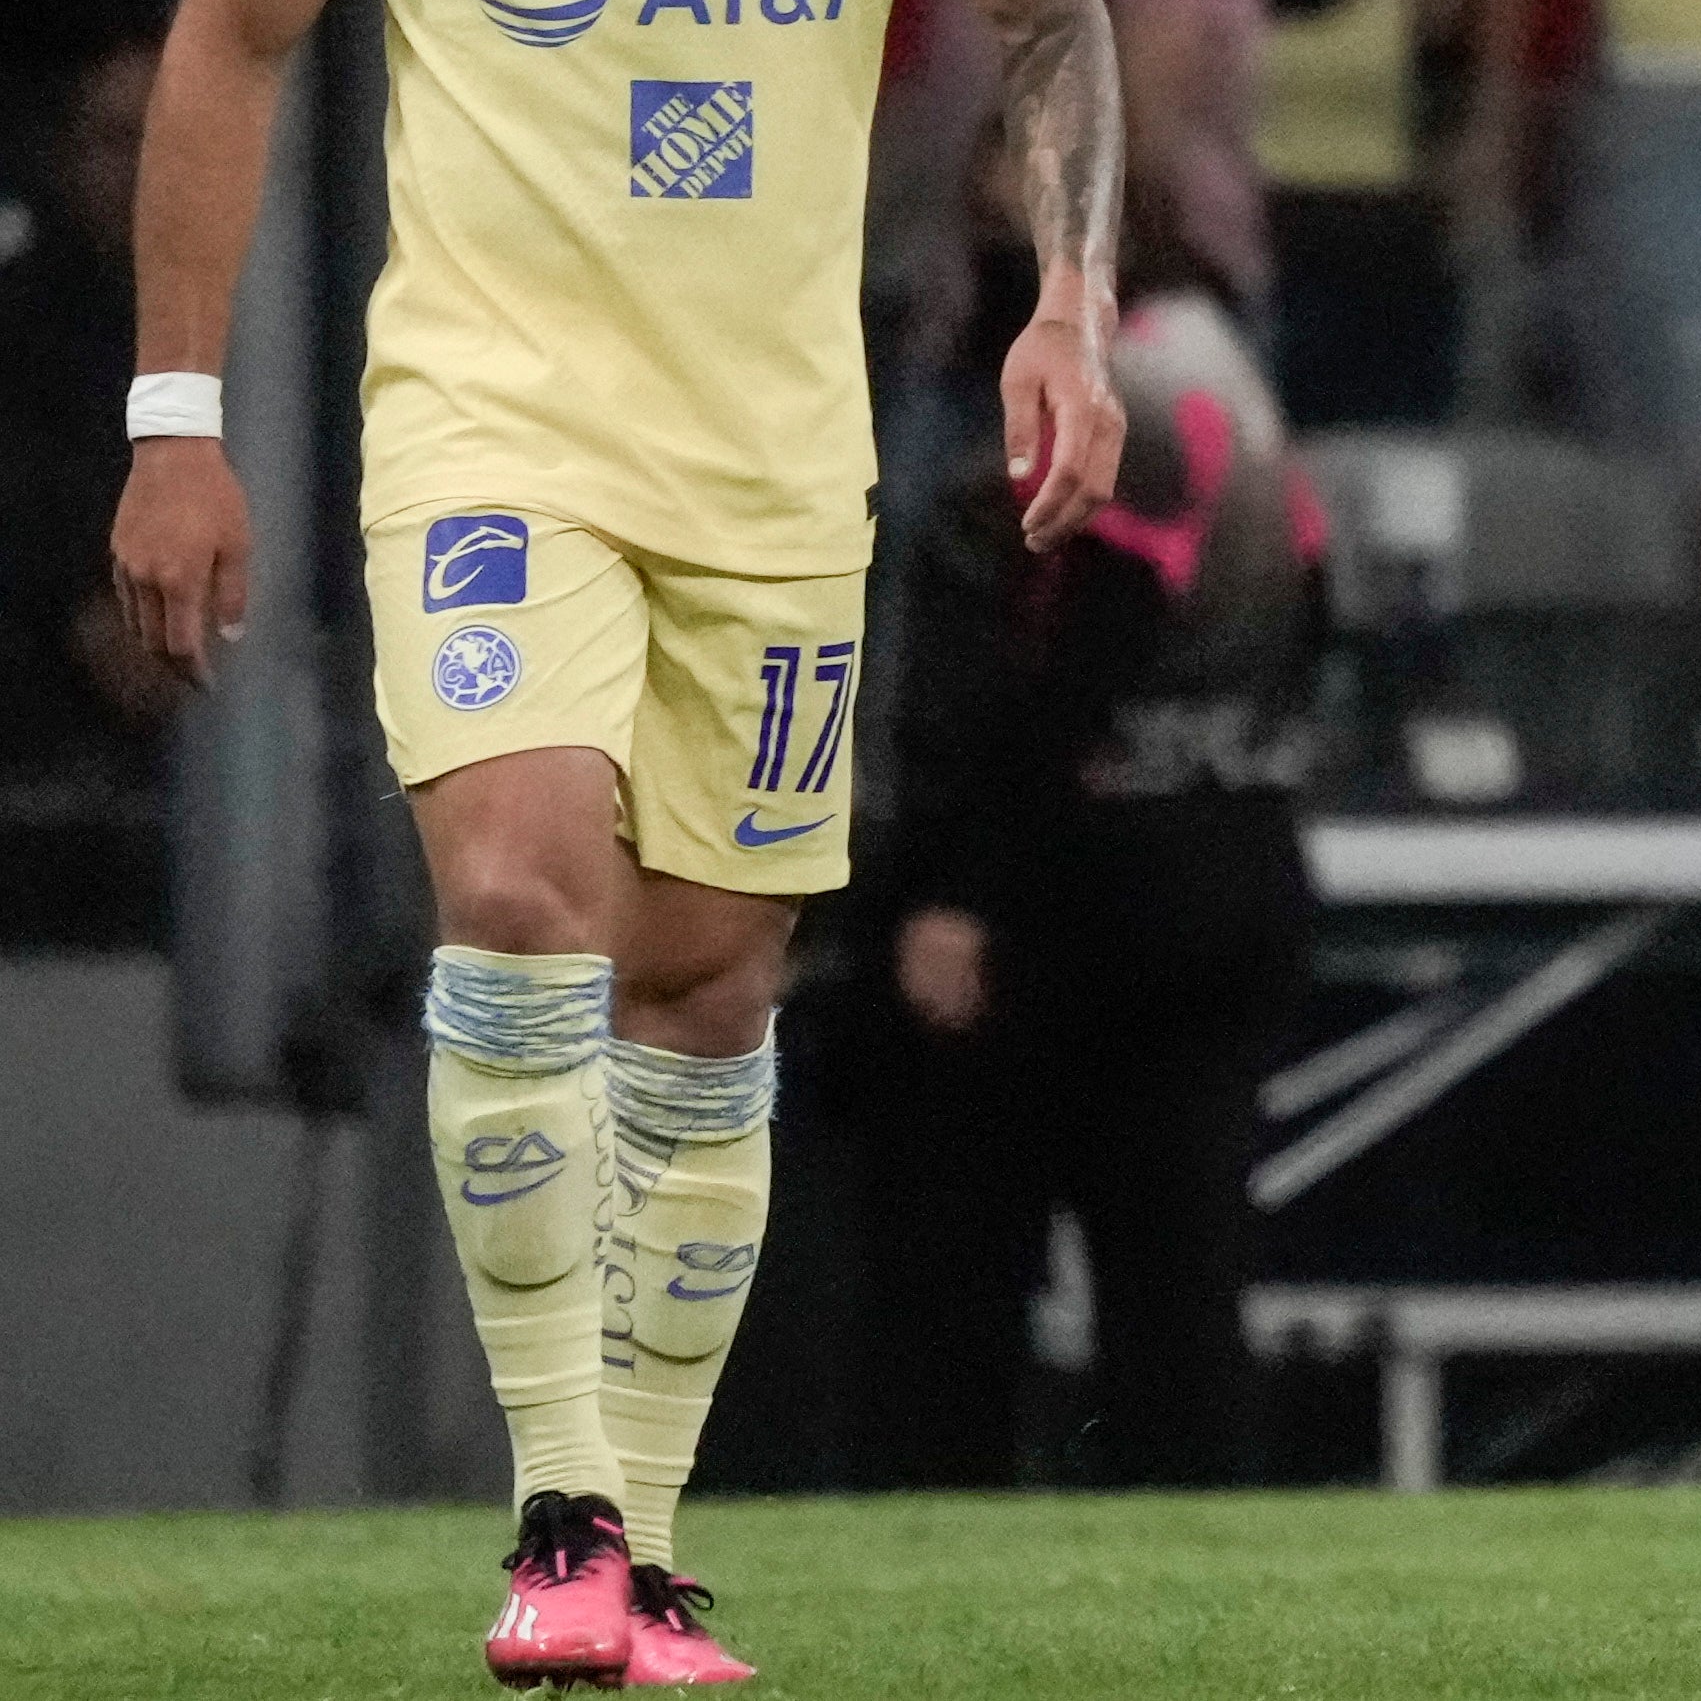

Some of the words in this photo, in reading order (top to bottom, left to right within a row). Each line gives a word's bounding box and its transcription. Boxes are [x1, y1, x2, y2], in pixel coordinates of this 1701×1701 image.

[632, 81, 752, 197] HOME
[641, 93, 694, 139] THE
[680, 125, 752, 198] DEPOT
[747, 641, 856, 793] 17
